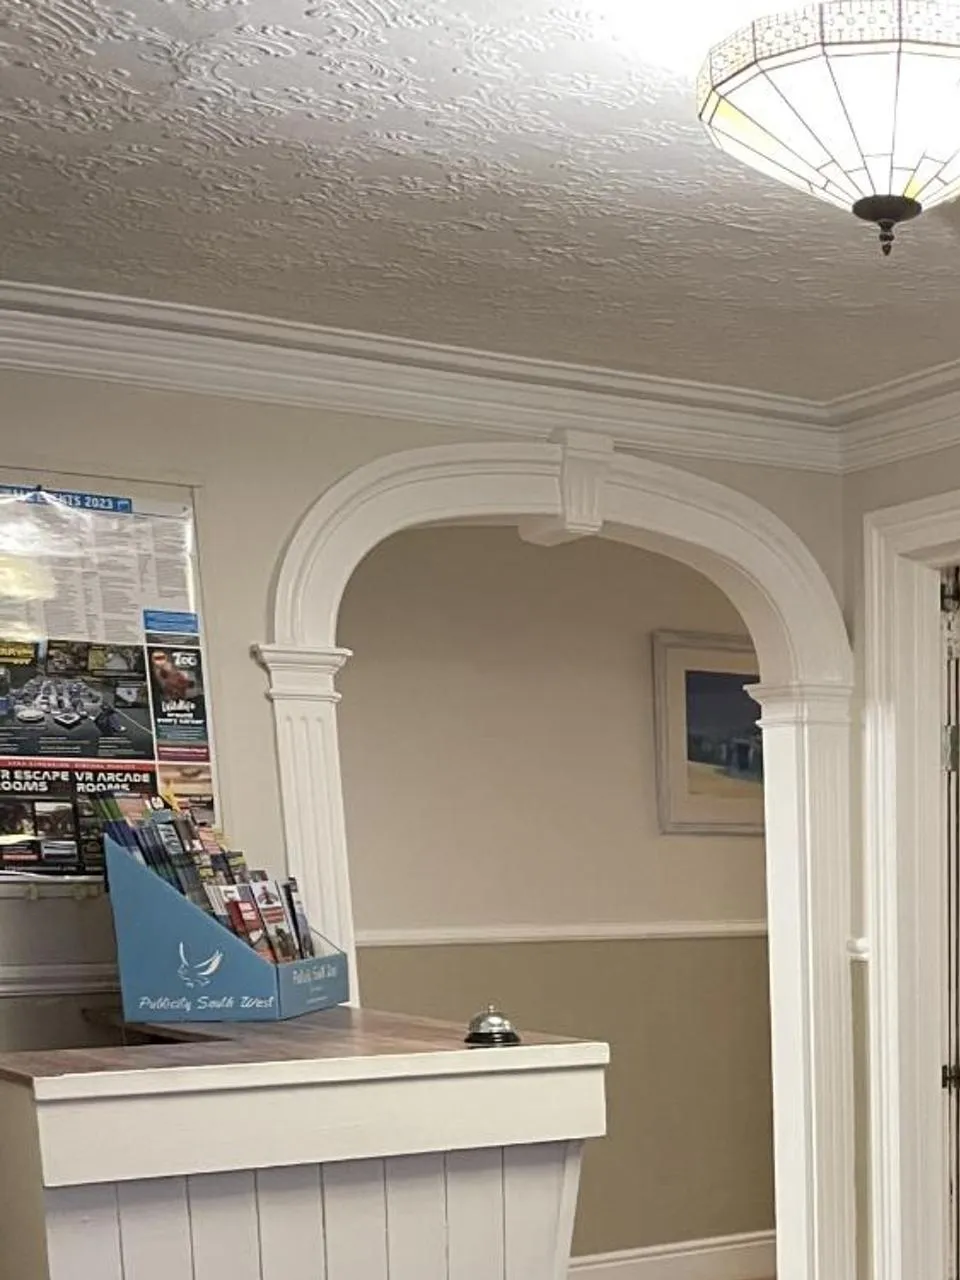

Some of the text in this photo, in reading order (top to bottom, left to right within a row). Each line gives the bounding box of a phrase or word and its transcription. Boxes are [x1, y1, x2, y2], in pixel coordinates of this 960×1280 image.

[0, 769, 70, 782] R ESCAPE
[74, 771, 150, 784] VR ARCADE
[0, 780, 49, 792] OOMS
[138, 994, 275, 1012] Publicity South West
